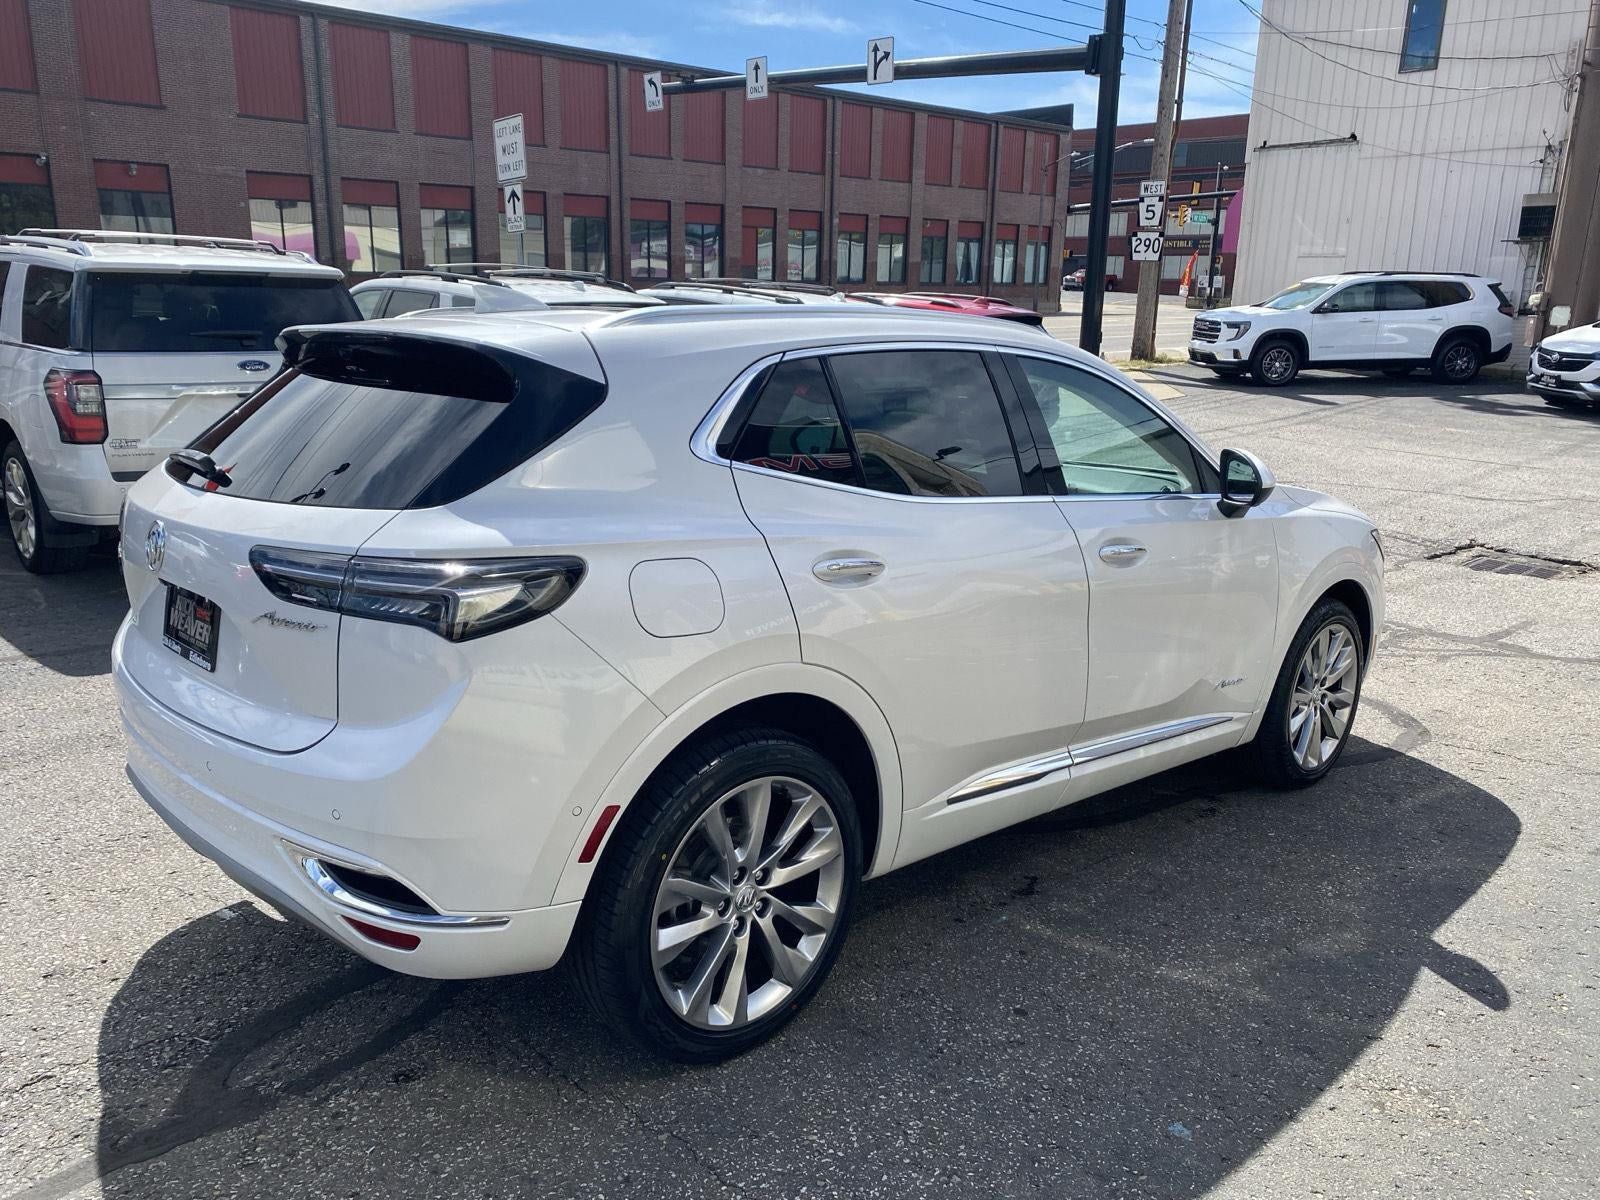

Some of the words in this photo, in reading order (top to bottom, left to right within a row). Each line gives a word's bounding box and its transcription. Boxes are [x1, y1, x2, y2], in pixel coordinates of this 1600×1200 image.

[750, 86, 764, 95] ONLY
[648, 99, 660, 107] ONLY
[497, 126, 507, 138] LEFT
[509, 123, 521, 135] LANE
[502, 141, 518, 156] MUST
[499, 162, 511, 173] TURN
[512, 160, 523, 171] LEFT
[1143, 183, 1163, 194] WEST
[1145, 204, 1156, 220] 5
[1133, 237, 1161, 254] 290
[169, 607, 212, 645] WEAVER
